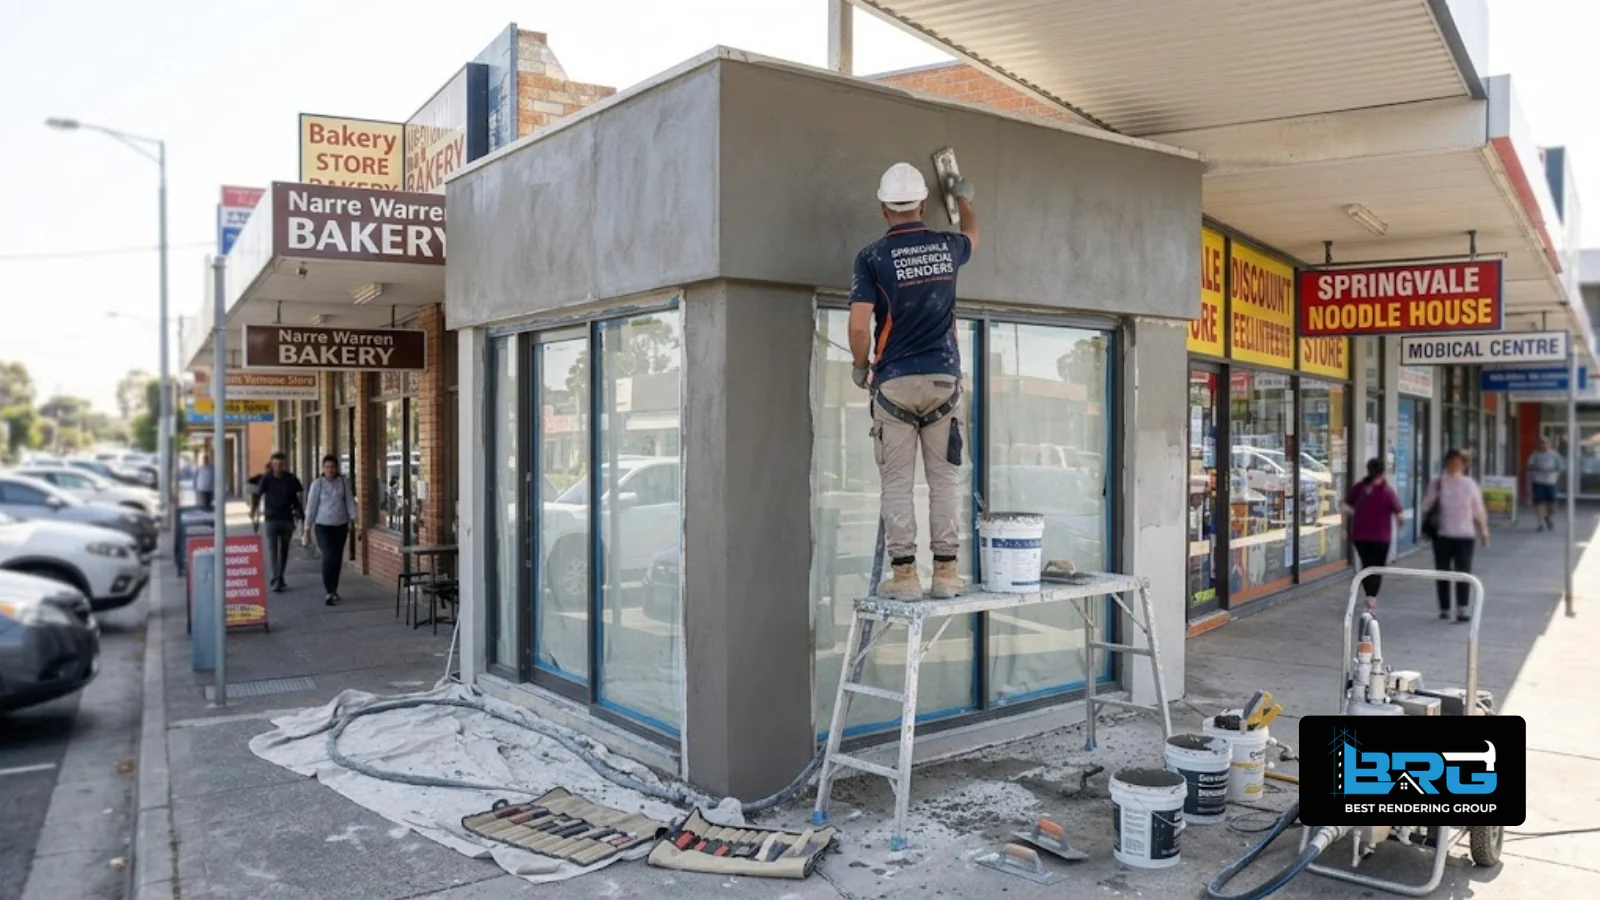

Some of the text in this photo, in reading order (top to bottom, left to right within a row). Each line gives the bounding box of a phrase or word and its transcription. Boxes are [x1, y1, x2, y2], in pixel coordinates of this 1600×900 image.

[309, 123, 397, 155] Bakery
[316, 152, 389, 176] STORE
[288, 190, 446, 222] Narre Warre
[896, 262, 954, 281] RENDERS
[1317, 266, 1480, 301] SPRINGVALE
[1308, 298, 1492, 330] NOODLE HOUSE
[278, 329, 394, 346] Narre Warren
[1408, 338, 1559, 359] MOBICAL CENTRE
[278, 345, 395, 366] BAKERY
[1304, 337, 1342, 369] STORE
